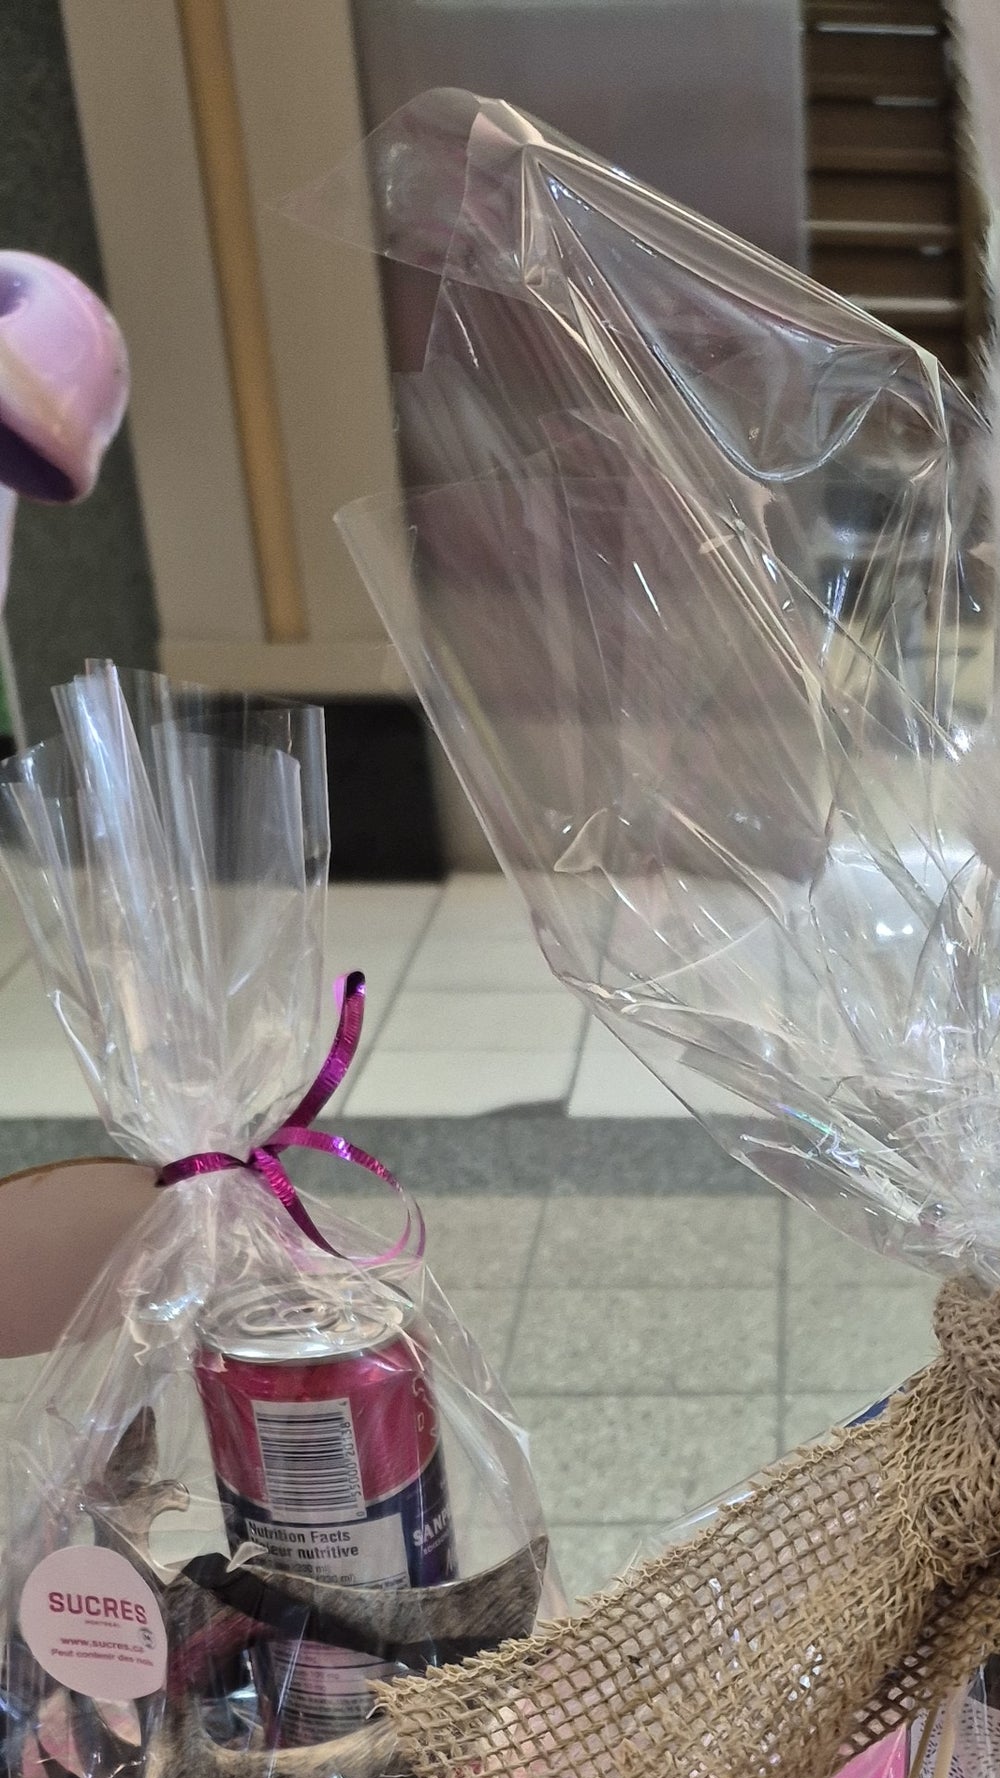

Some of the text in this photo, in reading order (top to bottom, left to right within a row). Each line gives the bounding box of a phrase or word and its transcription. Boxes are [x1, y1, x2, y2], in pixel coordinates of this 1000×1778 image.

[249, 1521, 351, 1543] Nutrition Facts
[298, 1546, 359, 1560] nutritive
[48, 1592, 148, 1625] SUCRES
